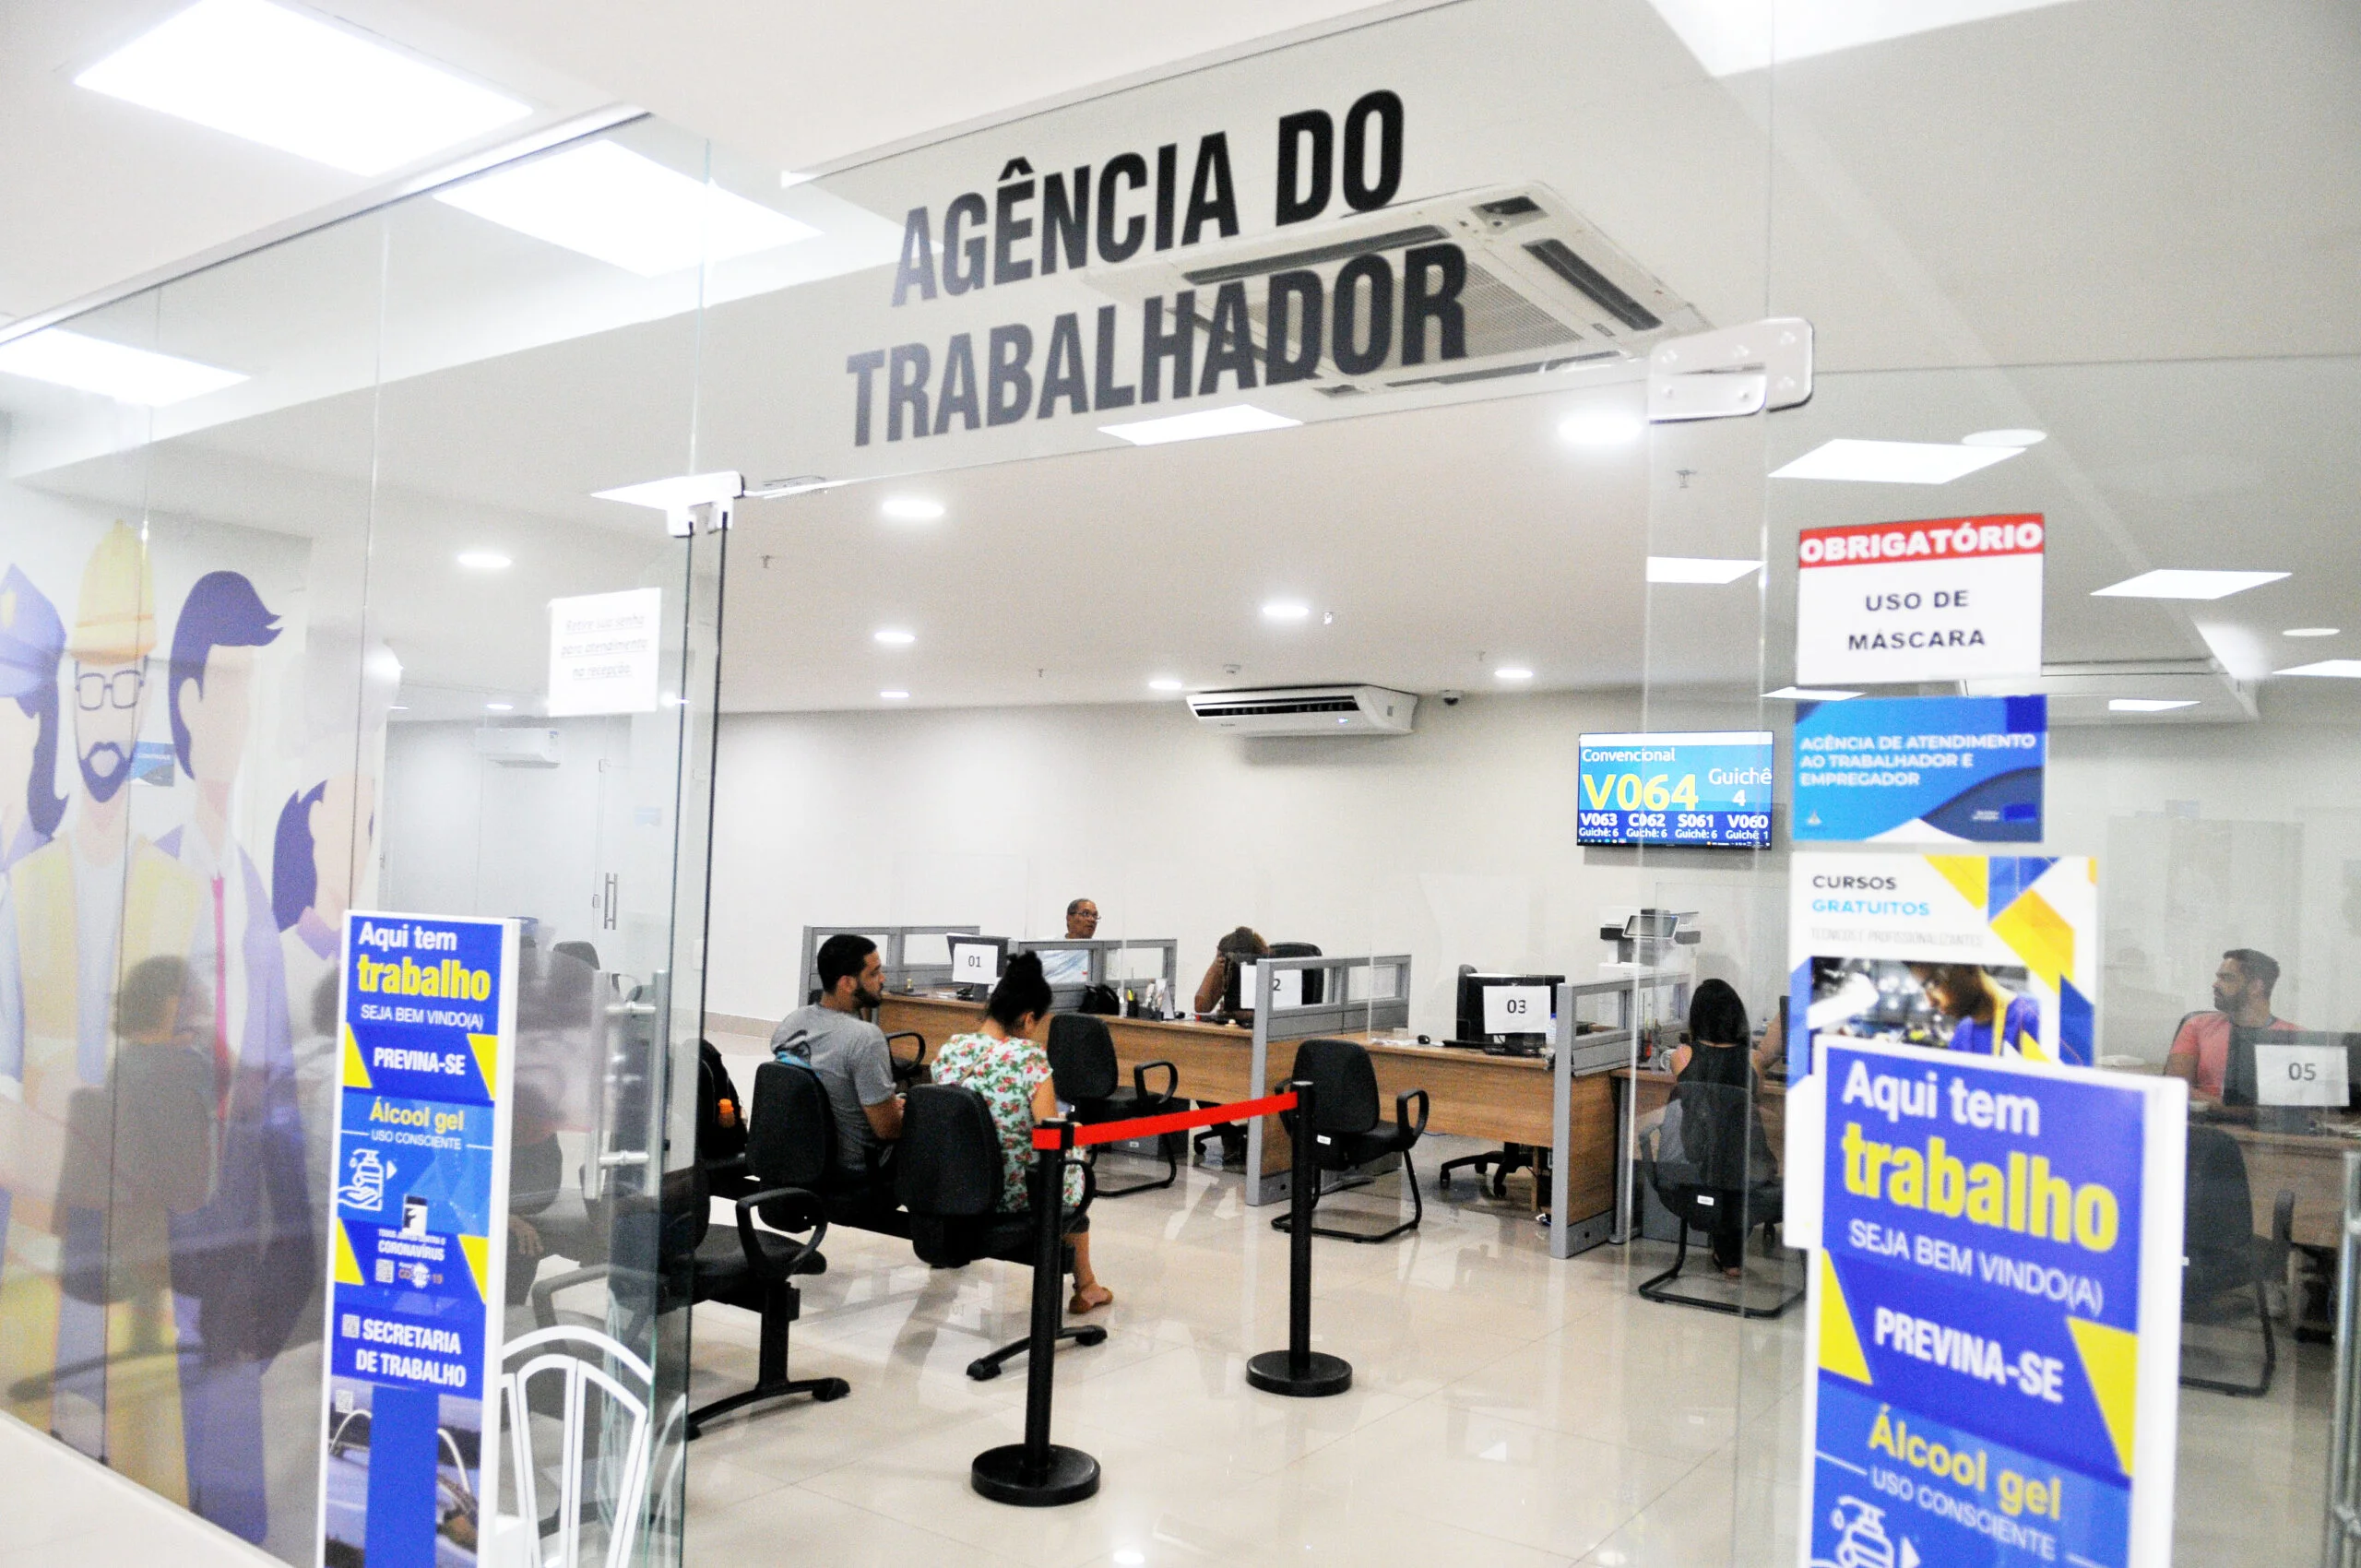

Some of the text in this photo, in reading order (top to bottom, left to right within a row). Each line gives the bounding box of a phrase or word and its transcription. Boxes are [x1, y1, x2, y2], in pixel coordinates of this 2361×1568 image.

[891, 89, 1404, 307] AGÊNCIA DO
[847, 243, 1467, 446] TRABALHADOR
[1799, 522, 2043, 563] OBRIGATÓRIO
[1866, 590, 1969, 612] USO DE
[1848, 629, 1986, 651] MÁSCARA
[1800, 733, 2036, 751] AGÊNCIA DE ATENDIMENTO
[1582, 748, 1676, 762] Convencional
[1800, 754, 1974, 768] AO TRABALHADOR E
[1583, 767, 1773, 811] V064 Guichê
[1800, 772, 1920, 786] EMPREGADOR
[1732, 789, 1747, 806] 4
[1581, 813, 1768, 828] V063 C062 S061 V060
[1579, 827, 1619, 837] Guichê: 6
[1626, 827, 1667, 838] Guichê: 6
[1675, 828, 1717, 839] Guichê: 6
[1763, 831, 1769, 839] 1
[1812, 875, 1897, 890] CURSOS
[1812, 899, 1930, 916] GRATUITOS
[359, 921, 457, 952] Aqui tem
[968, 956, 981, 968] 01
[358, 954, 492, 1001] trabalho
[361, 1004, 483, 1031] SEJA BEM VINDO(A)
[1507, 999, 1526, 1014] 03
[374, 1047, 466, 1075] PREVINA-SE
[2288, 1063, 2316, 1081] 05
[1842, 1060, 2040, 1136] Aqui tem
[370, 1096, 464, 1134] Álcool gel
[371, 1130, 461, 1150] USO CONSCIENTE
[1842, 1122, 2118, 1253] trabalho
[378, 1240, 445, 1262] CORONAVÍRUS
[1849, 1218, 2103, 1317] SEJA BEM VINDO(A)
[362, 1319, 461, 1355] SECRETARIA
[1875, 1306, 2064, 1404] PREVINA-SE
[356, 1349, 467, 1387] DE TRABALHO
[1869, 1404, 2061, 1521] Álcool gel
[1871, 1466, 2057, 1562] USO CONSCIENTE
